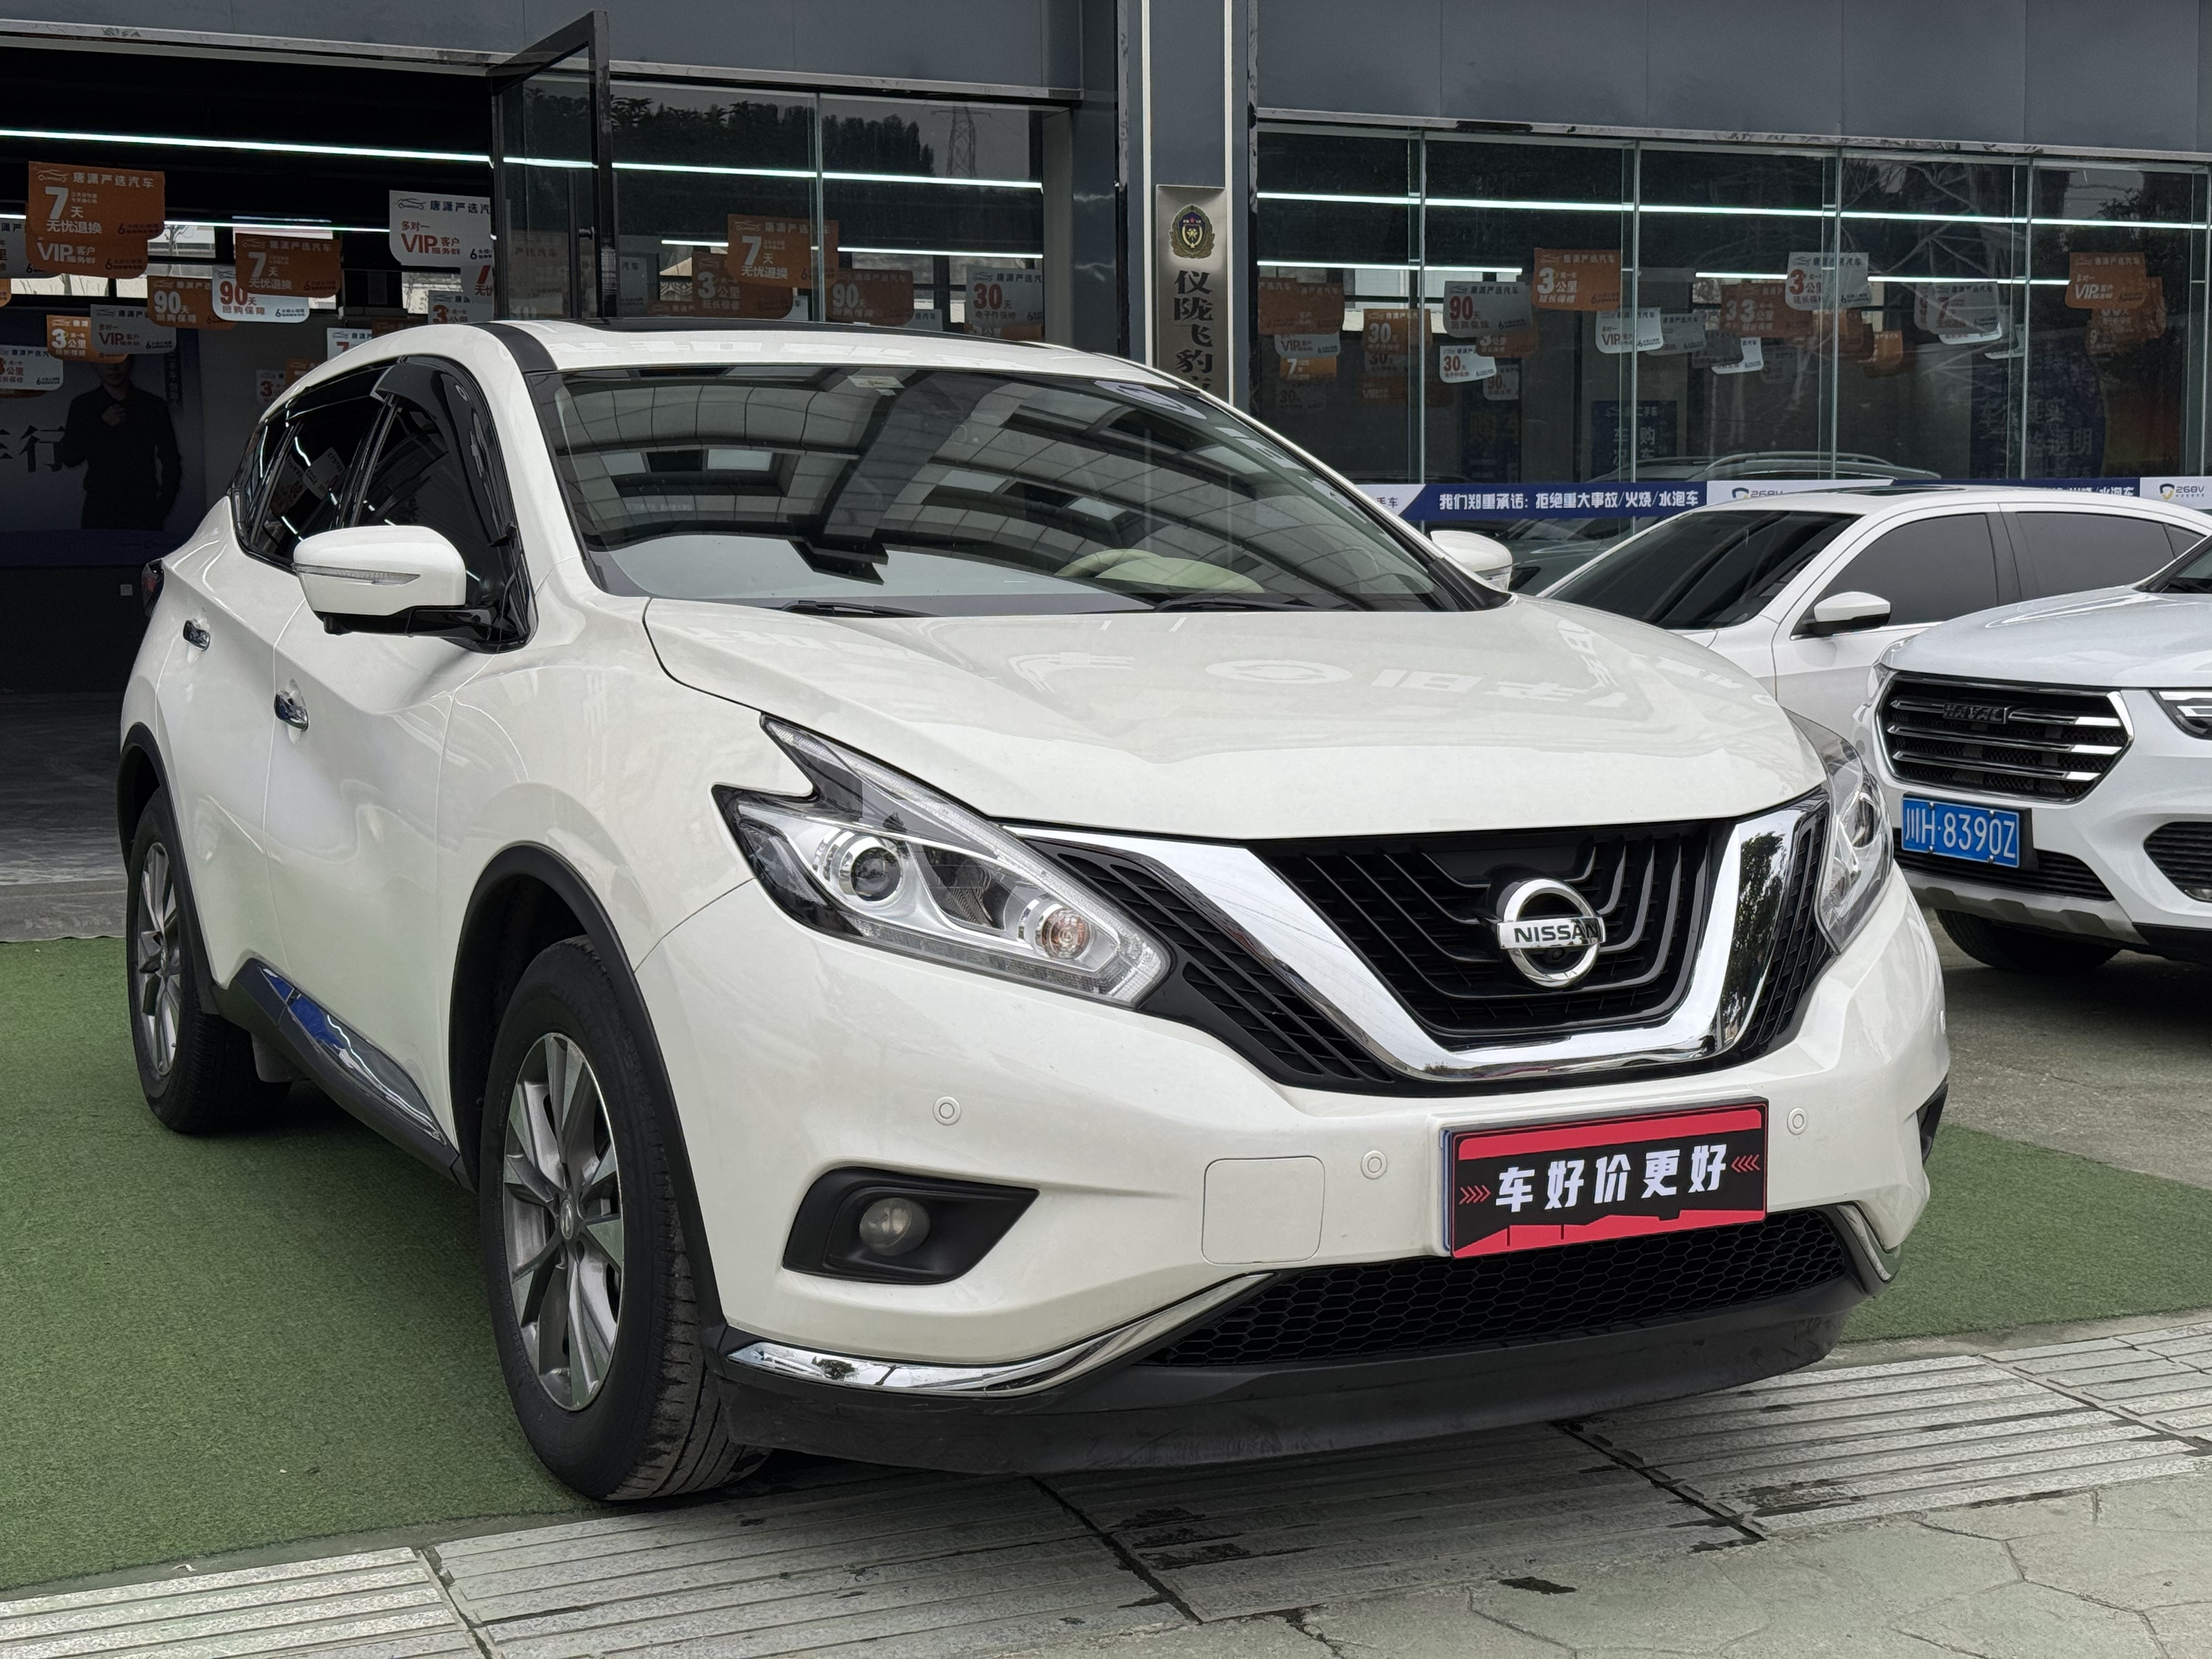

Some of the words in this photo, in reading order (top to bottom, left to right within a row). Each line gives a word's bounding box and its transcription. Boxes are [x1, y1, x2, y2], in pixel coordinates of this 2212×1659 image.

[73, 172, 154, 189] 唐潇严选汽车
[45, 186, 69, 219] 7
[70, 206, 84, 218] 天
[46, 220, 103, 234] 无忧退换
[401, 220, 430, 232] 多对一
[401, 233, 438, 254] VIP
[440, 236, 460, 247] 客户
[36, 242, 74, 262] VIP
[77, 246, 95, 256] 客户
[742, 235, 762, 266] 7
[248, 251, 268, 278] 7
[763, 253, 774, 264] 天
[268, 267, 279, 277] 天
[741, 266, 788, 279] 无忧退换
[249, 278, 292, 290] 无忧退换
[698, 271, 716, 299] 3
[1537, 267, 1555, 295] 3
[1555, 280, 1578, 294] 公里
[1790, 269, 1805, 295] 3
[221, 281, 247, 305] 90
[717, 286, 741, 299] 公里
[832, 283, 859, 308] 90
[973, 283, 1003, 309] 30
[2075, 284, 2100, 300] VIP
[154, 290, 181, 314] 90
[247, 297, 257, 306] 天
[1003, 300, 1012, 309] 天
[1794, 296, 1821, 304] 延长保
[180, 304, 189, 314] 天
[223, 305, 266, 315] 回购保障
[433, 304, 448, 324] 3
[1449, 296, 1474, 320] 90
[1474, 311, 1481, 319] 天
[1740, 298, 1756, 323] 3
[52, 328, 67, 349] 3
[99, 332, 125, 345] VIP
[1368, 323, 1392, 343] 30
[1602, 334, 1620, 346] VIP
[67, 339, 87, 349] 公里
[1280, 340, 1300, 351] VIP
[1287, 358, 1297, 375] 7
[1443, 356, 1460, 371] 30
[1487, 374, 1502, 389] 90
[1943, 703, 2004, 723] HAVAL
[1513, 923, 1598, 943] NISSAN
[1494, 1143, 1728, 1213] 车好价更好
